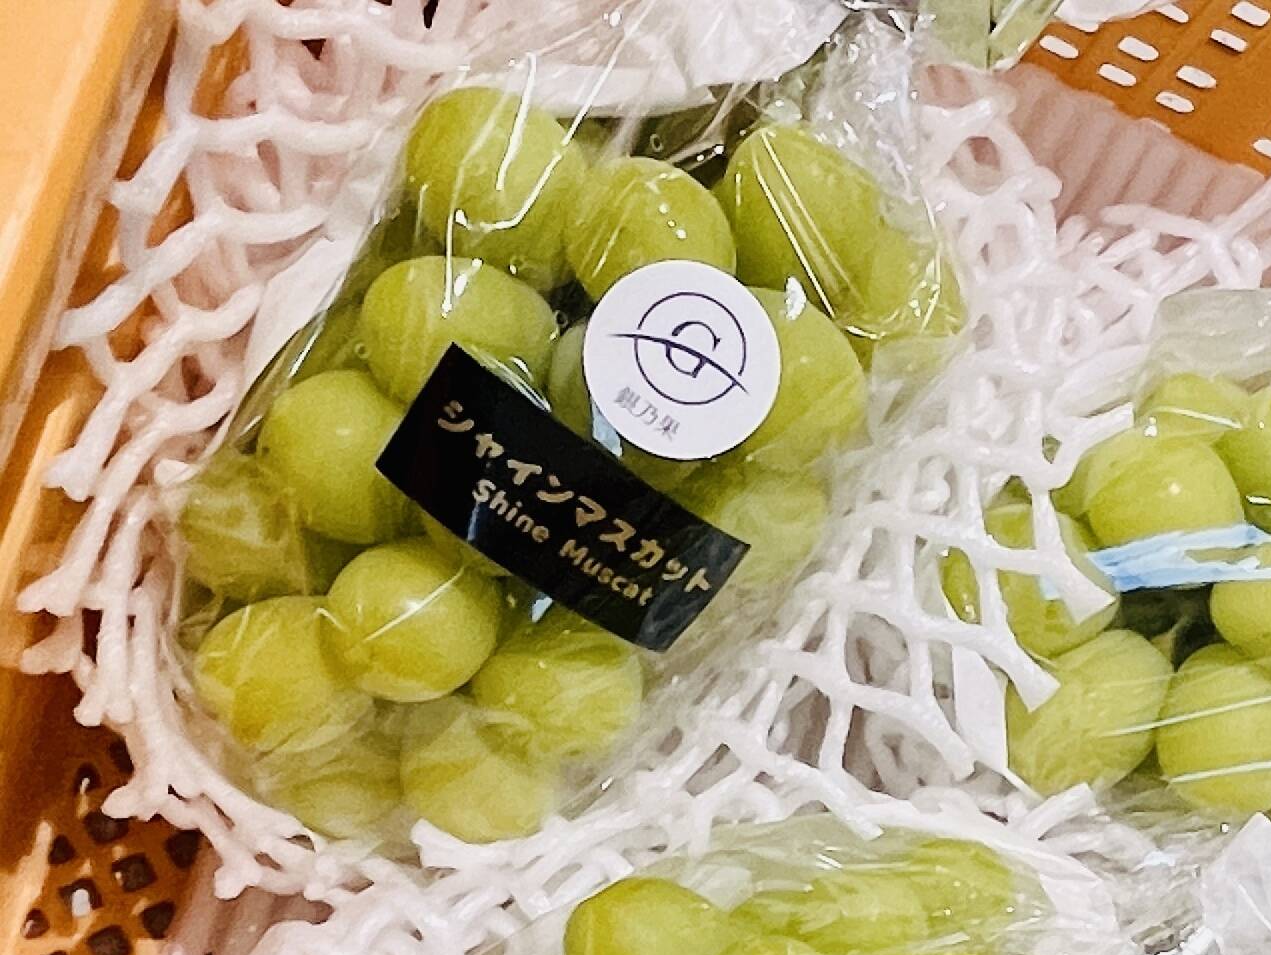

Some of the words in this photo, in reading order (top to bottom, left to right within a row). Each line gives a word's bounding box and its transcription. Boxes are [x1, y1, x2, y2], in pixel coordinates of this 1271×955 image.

[436, 400, 713, 595] シャインマスカット
[472, 480, 550, 544] Shine
[559, 540, 655, 606] Muscat
